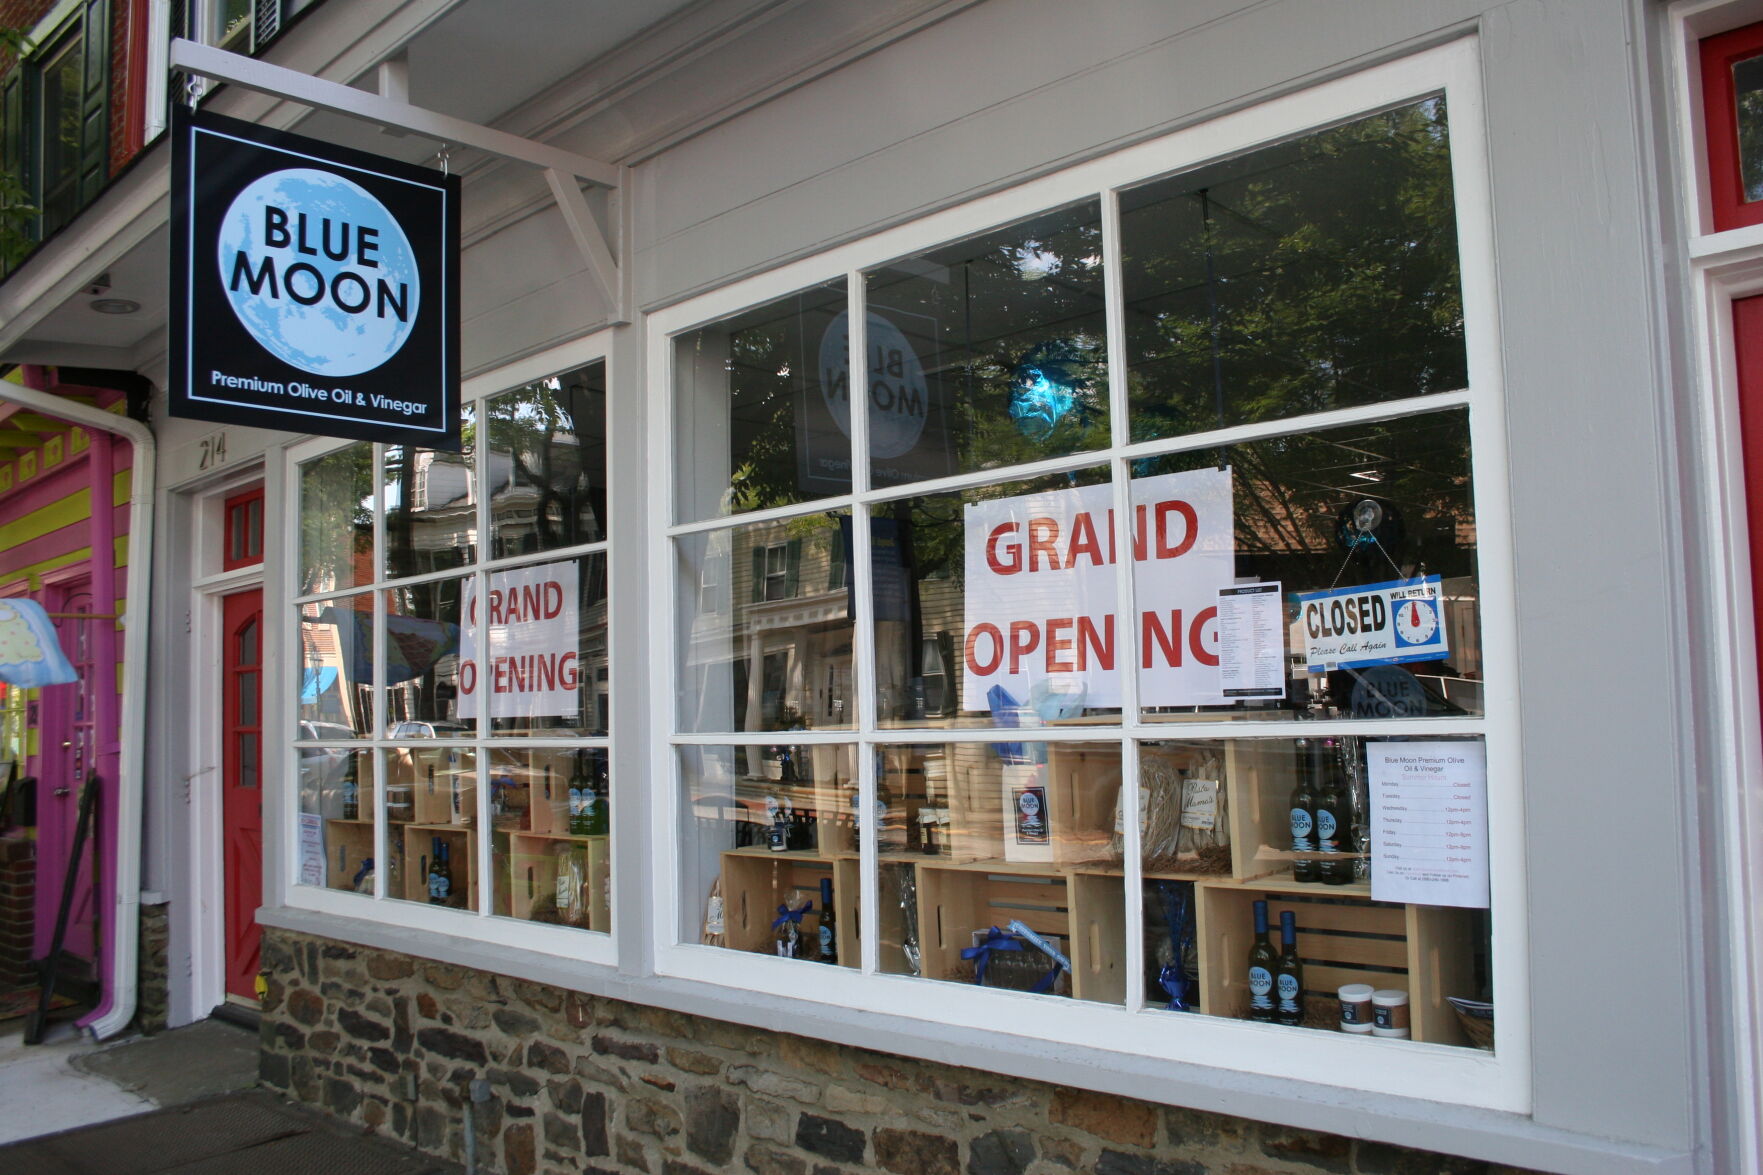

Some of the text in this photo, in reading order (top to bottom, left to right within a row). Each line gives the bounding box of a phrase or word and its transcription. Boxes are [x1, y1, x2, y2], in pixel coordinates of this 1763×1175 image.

[265, 204, 379, 269] BLUE
[230, 250, 408, 322] MOON
[211, 370, 428, 415] Premium Olive Oil & Vinegar
[199, 432, 226, 470] 214
[986, 500, 1198, 575] GRAND
[1307, 594, 1386, 639] CLOSED
[1390, 592, 1406, 600] WILL
[965, 605, 1219, 676] OPENNG
[1310, 641, 1387, 656] Please Call Again
[460, 651, 577, 695] OENING
